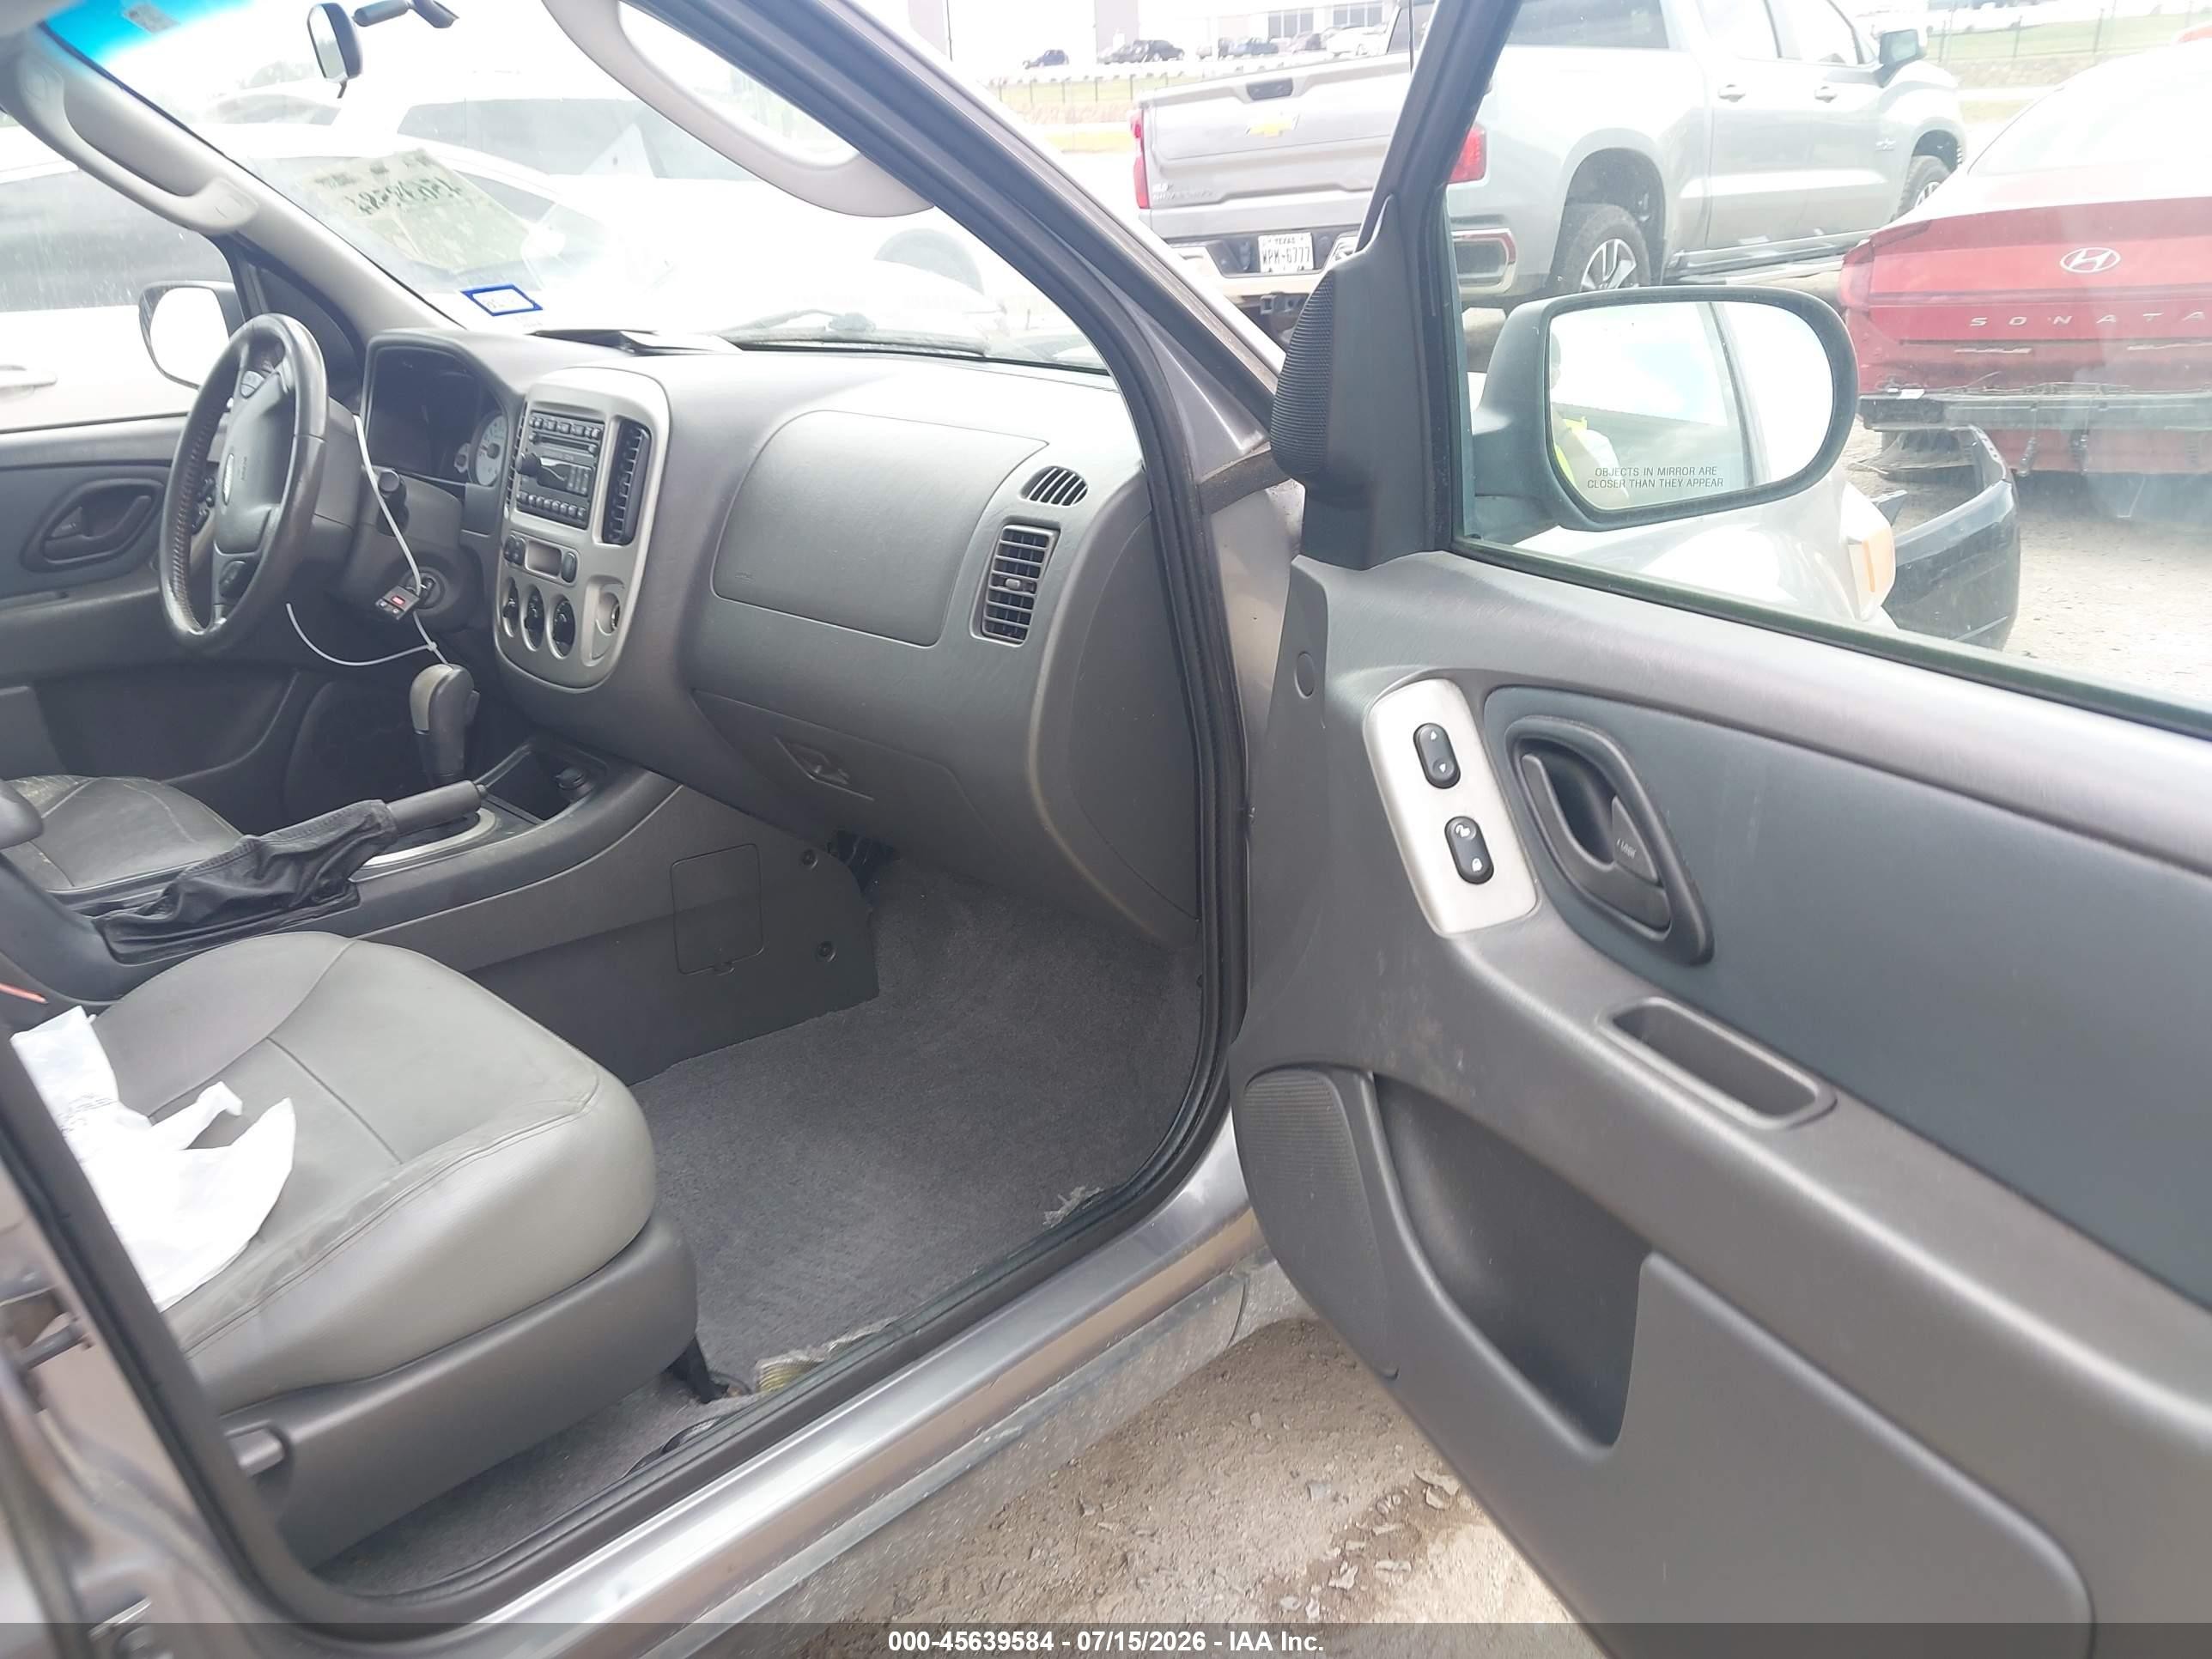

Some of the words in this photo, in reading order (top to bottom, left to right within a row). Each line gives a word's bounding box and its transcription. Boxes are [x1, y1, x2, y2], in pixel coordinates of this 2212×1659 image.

[1970, 311, 2206, 327] SONATA
[1595, 467, 1639, 477] OBJECTS
[1644, 466, 1654, 476] IN
[1657, 466, 1695, 476] MIRROR
[1698, 466, 1717, 476] ARE
[1587, 479, 1626, 489] CLOSER
[1629, 478, 1656, 488] THAN
[1658, 478, 1684, 488] THEY
[1686, 477, 1723, 488] APPEAR
